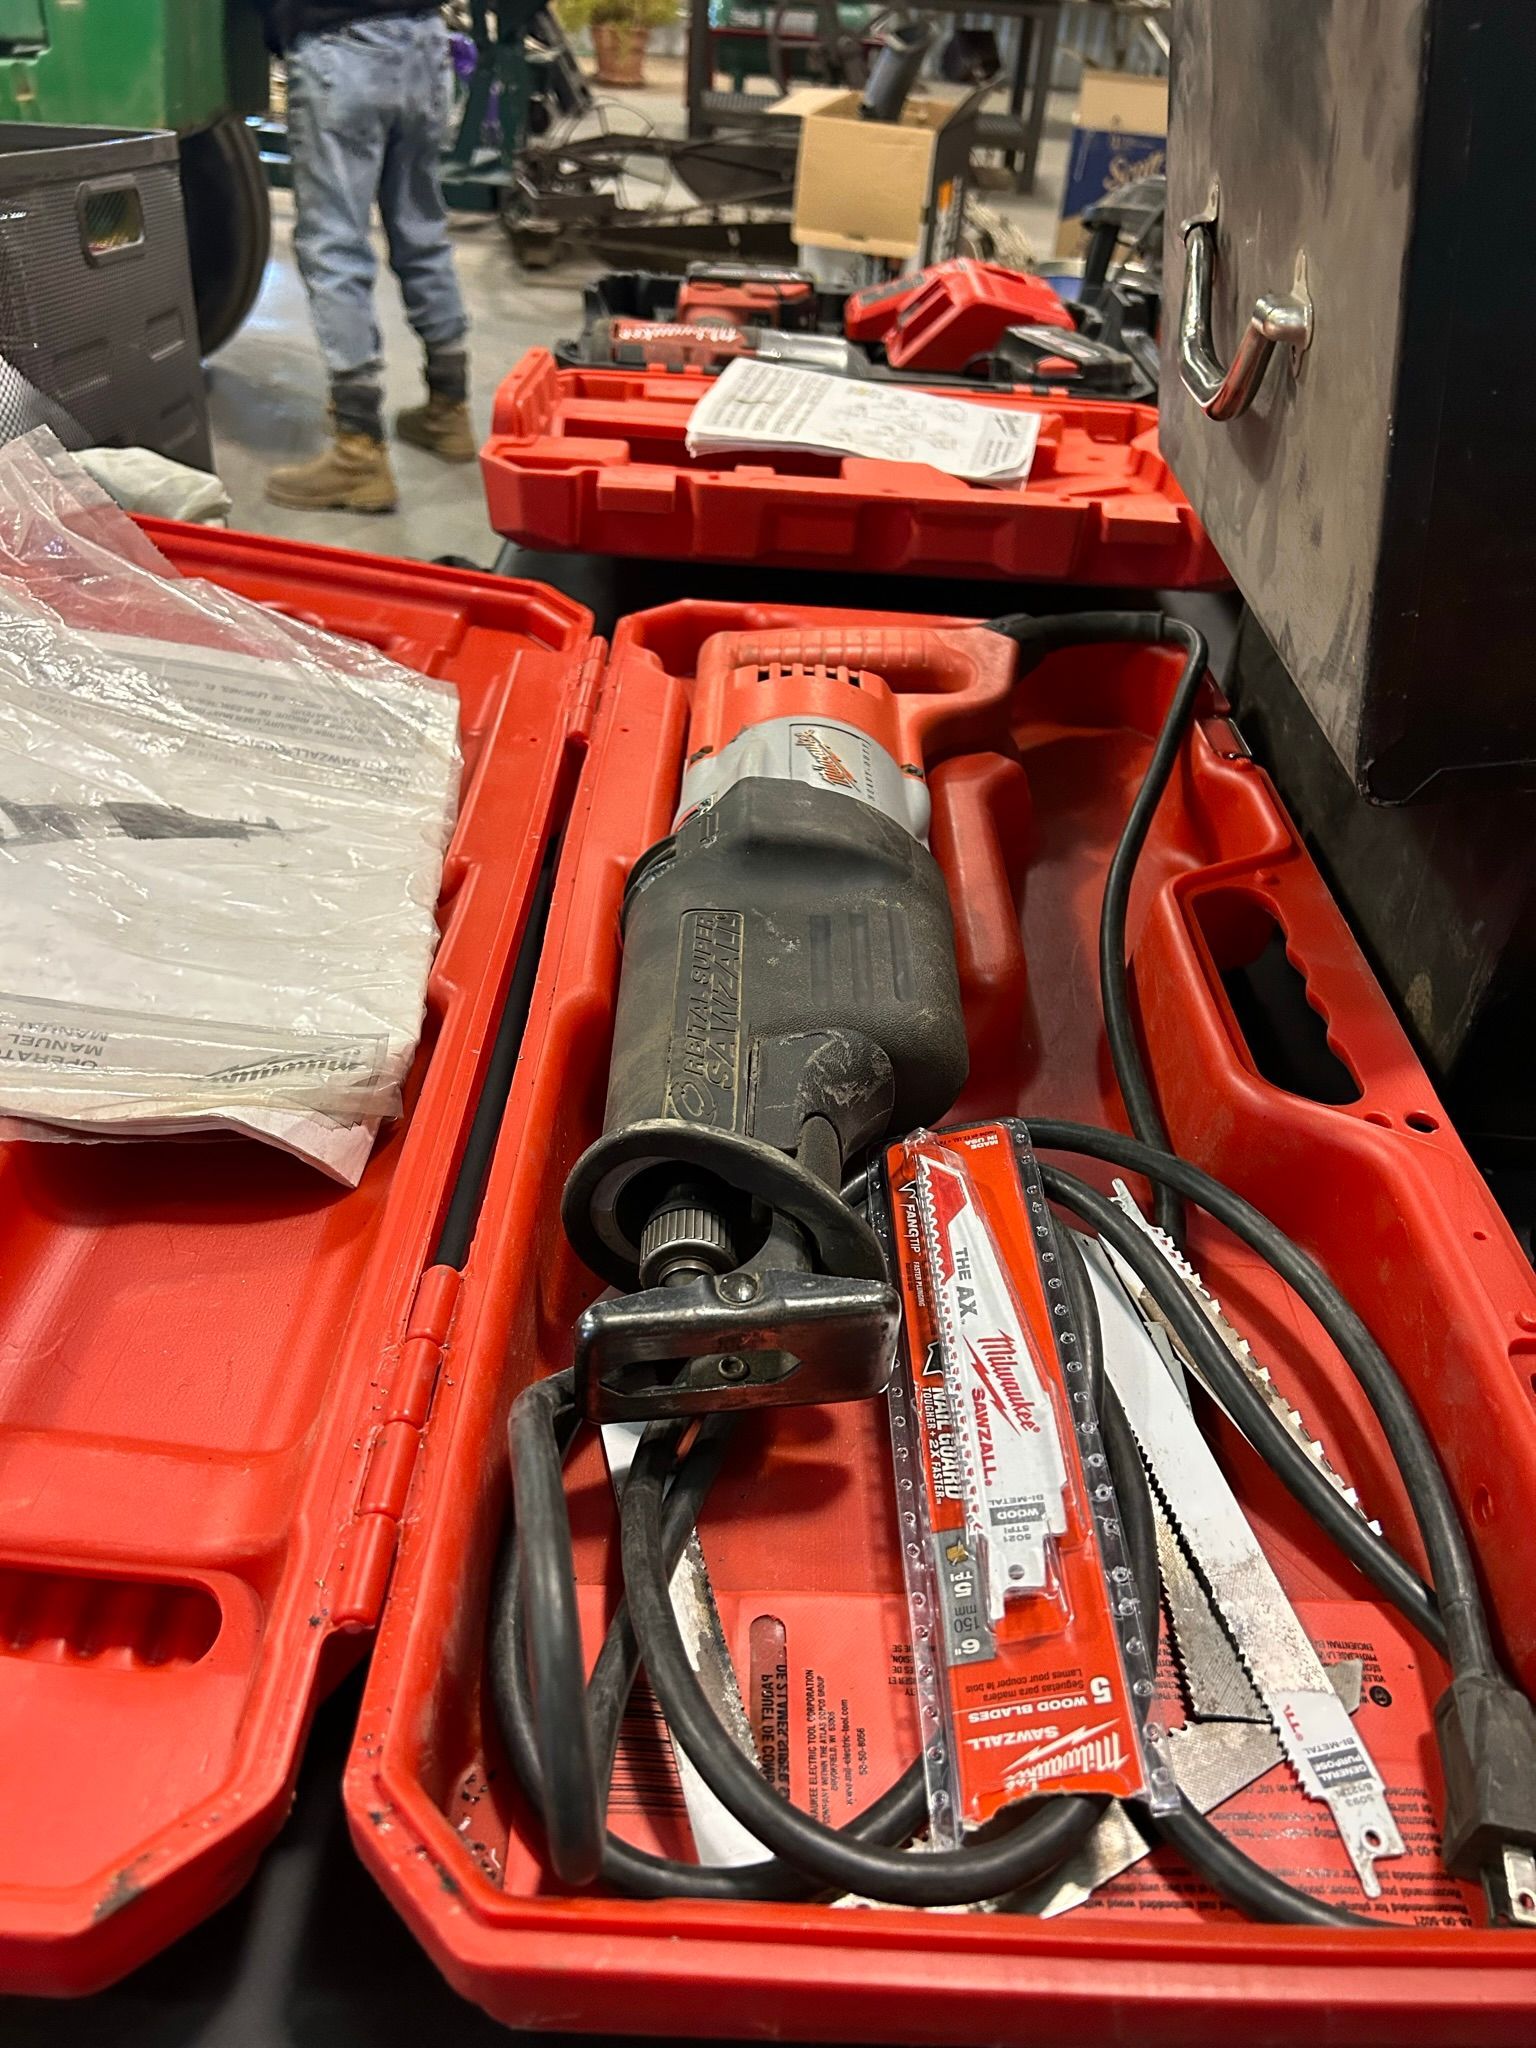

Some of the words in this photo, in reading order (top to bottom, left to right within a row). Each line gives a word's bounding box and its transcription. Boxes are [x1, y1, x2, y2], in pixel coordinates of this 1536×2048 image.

[690, 917, 714, 984] SUPER
[8, 1034, 104, 1057] MANUEL
[0, 1050, 98, 1069] OPERAT
[955, 1247, 973, 1281] THE
[922, 1387, 937, 1428] TOUGHER
[931, 1387, 955, 1430] NAIL
[929, 1439, 941, 1459] 2X
[938, 1433, 962, 1499] GUARD
[987, 1494, 1044, 1507] BI-METAL
[996, 1507, 1040, 1520] WOOD
[1003, 1534, 1032, 1543] 5021
[950, 1570, 974, 1582] TPI
[953, 1582, 973, 1598] 5
[954, 1604, 977, 1616] mm
[953, 1617, 980, 1633] 150
[954, 1638, 981, 1656] 6"
[996, 1673, 1027, 1688] couper
[1028, 1670, 1050, 1684] pour
[1051, 1668, 1083, 1681] Lames
[816, 1675, 826, 1697] GROUP
[965, 1682, 984, 1694] bois
[986, 1680, 995, 1691] le
[1018, 1685, 1039, 1698] para
[1041, 1679, 1085, 1694] Seguetas
[1089, 1675, 1113, 1705] 5
[805, 1669, 816, 1723] CORPORATION
[982, 1690, 1017, 1703] madera
[1037, 1695, 1089, 1712] WOOD
[967, 1704, 1034, 1724] BLADES
[806, 1725, 817, 1745] TOOL
[964, 1724, 1060, 1751] SAWZALL
[819, 1745, 828, 1758] THE
[1302, 1737, 1355, 1755] BI-METAL
[807, 1746, 818, 1785] ELECTRIC
[1003, 1731, 1131, 1792] Milwaukee
[1314, 1755, 1363, 1772] PURPOSE
[1317, 1764, 1368, 1782] GENERAL
